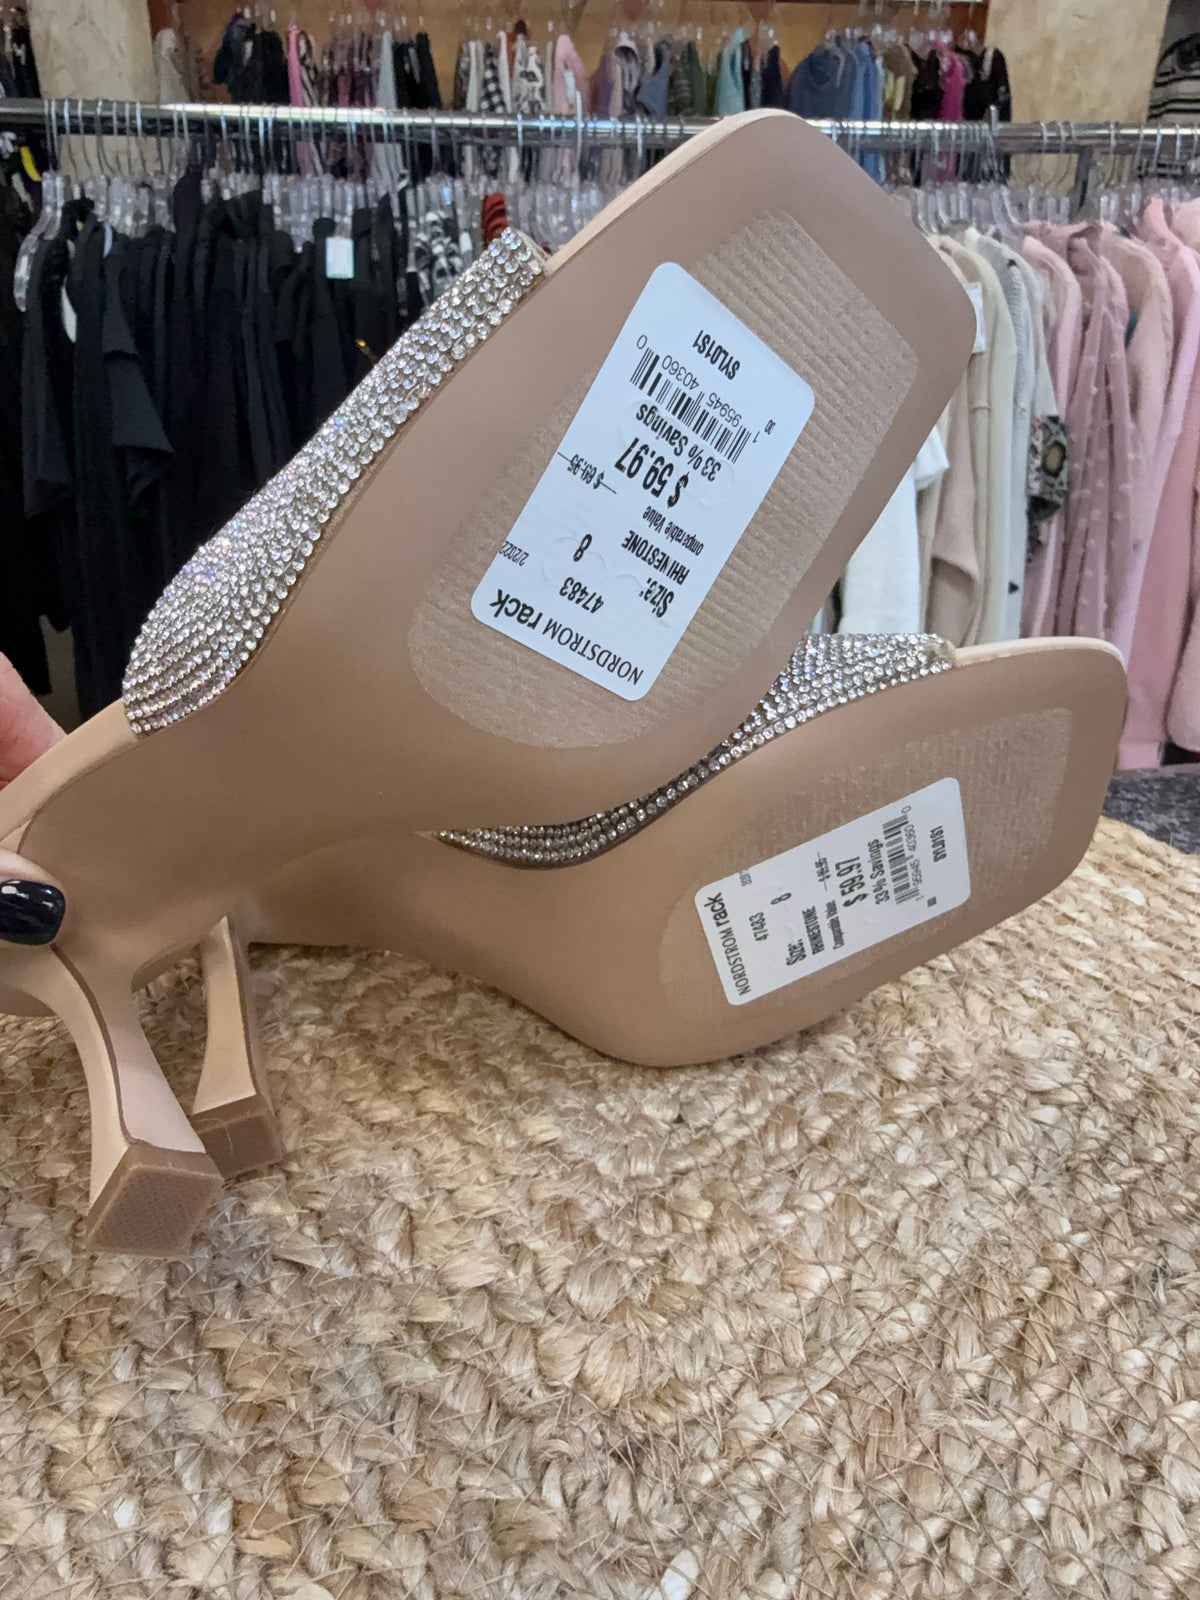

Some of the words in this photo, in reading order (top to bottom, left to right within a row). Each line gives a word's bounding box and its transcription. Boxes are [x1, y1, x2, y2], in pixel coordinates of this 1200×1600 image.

[636, 334, 648, 350] 0
[661, 355, 700, 390] 40360
[706, 392, 742, 428] 95945
[636, 404, 696, 457] Savings
[642, 506, 666, 534] Value
[573, 533, 593, 562] 8
[621, 530, 690, 585] RHINESTONE
[489, 589, 543, 629] rack
[559, 577, 604, 614] 47483
[639, 577, 674, 618] Size:
[542, 618, 644, 685] NORDSTROM
[867, 839, 885, 880] Savings
[704, 892, 730, 927] rack
[770, 892, 792, 905] 8
[749, 912, 769, 941] 47483
[802, 906, 825, 955] RHINESTONE
[719, 927, 751, 996] NORDSTROM
[786, 938, 807, 966] Size:
